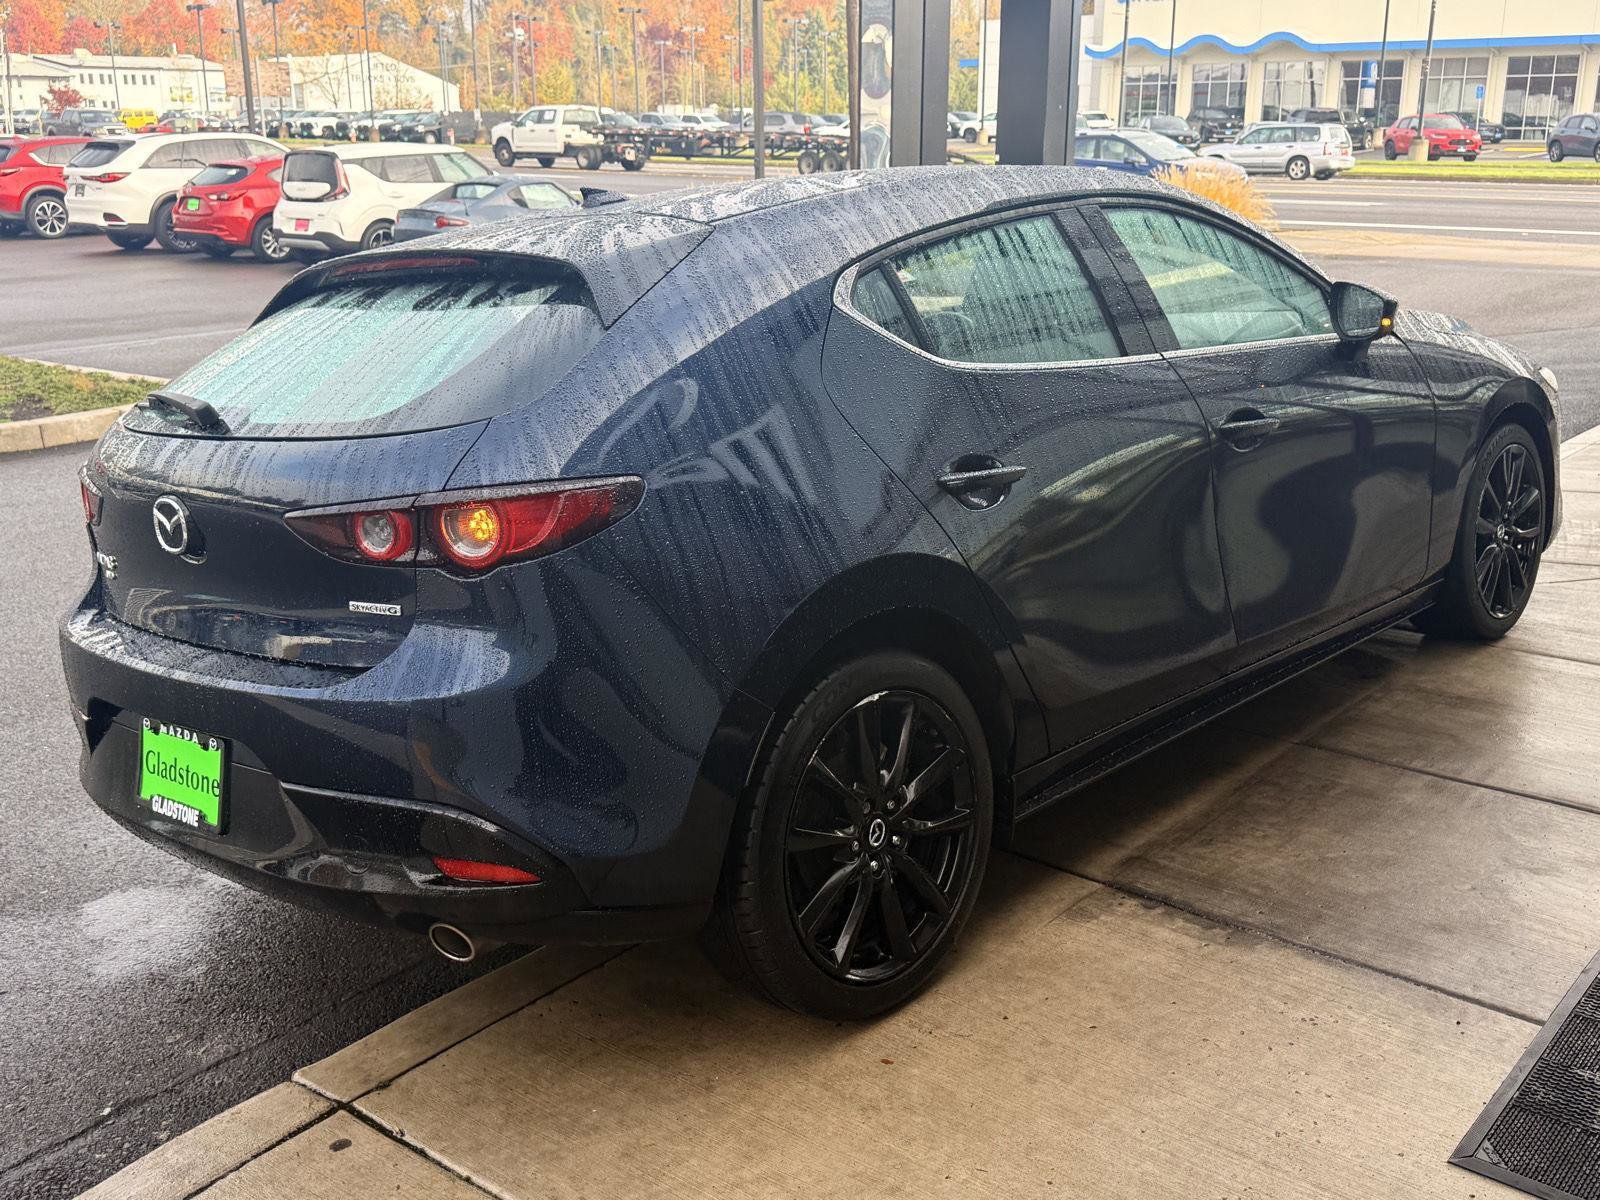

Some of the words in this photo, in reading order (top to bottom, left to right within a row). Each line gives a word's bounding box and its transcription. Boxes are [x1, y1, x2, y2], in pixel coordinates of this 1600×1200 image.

[350, 74, 385, 83] TRUKS
[159, 723, 199, 744] MAZDA
[145, 749, 220, 798] Gladstone
[152, 794, 200, 827] GLADSTONE
